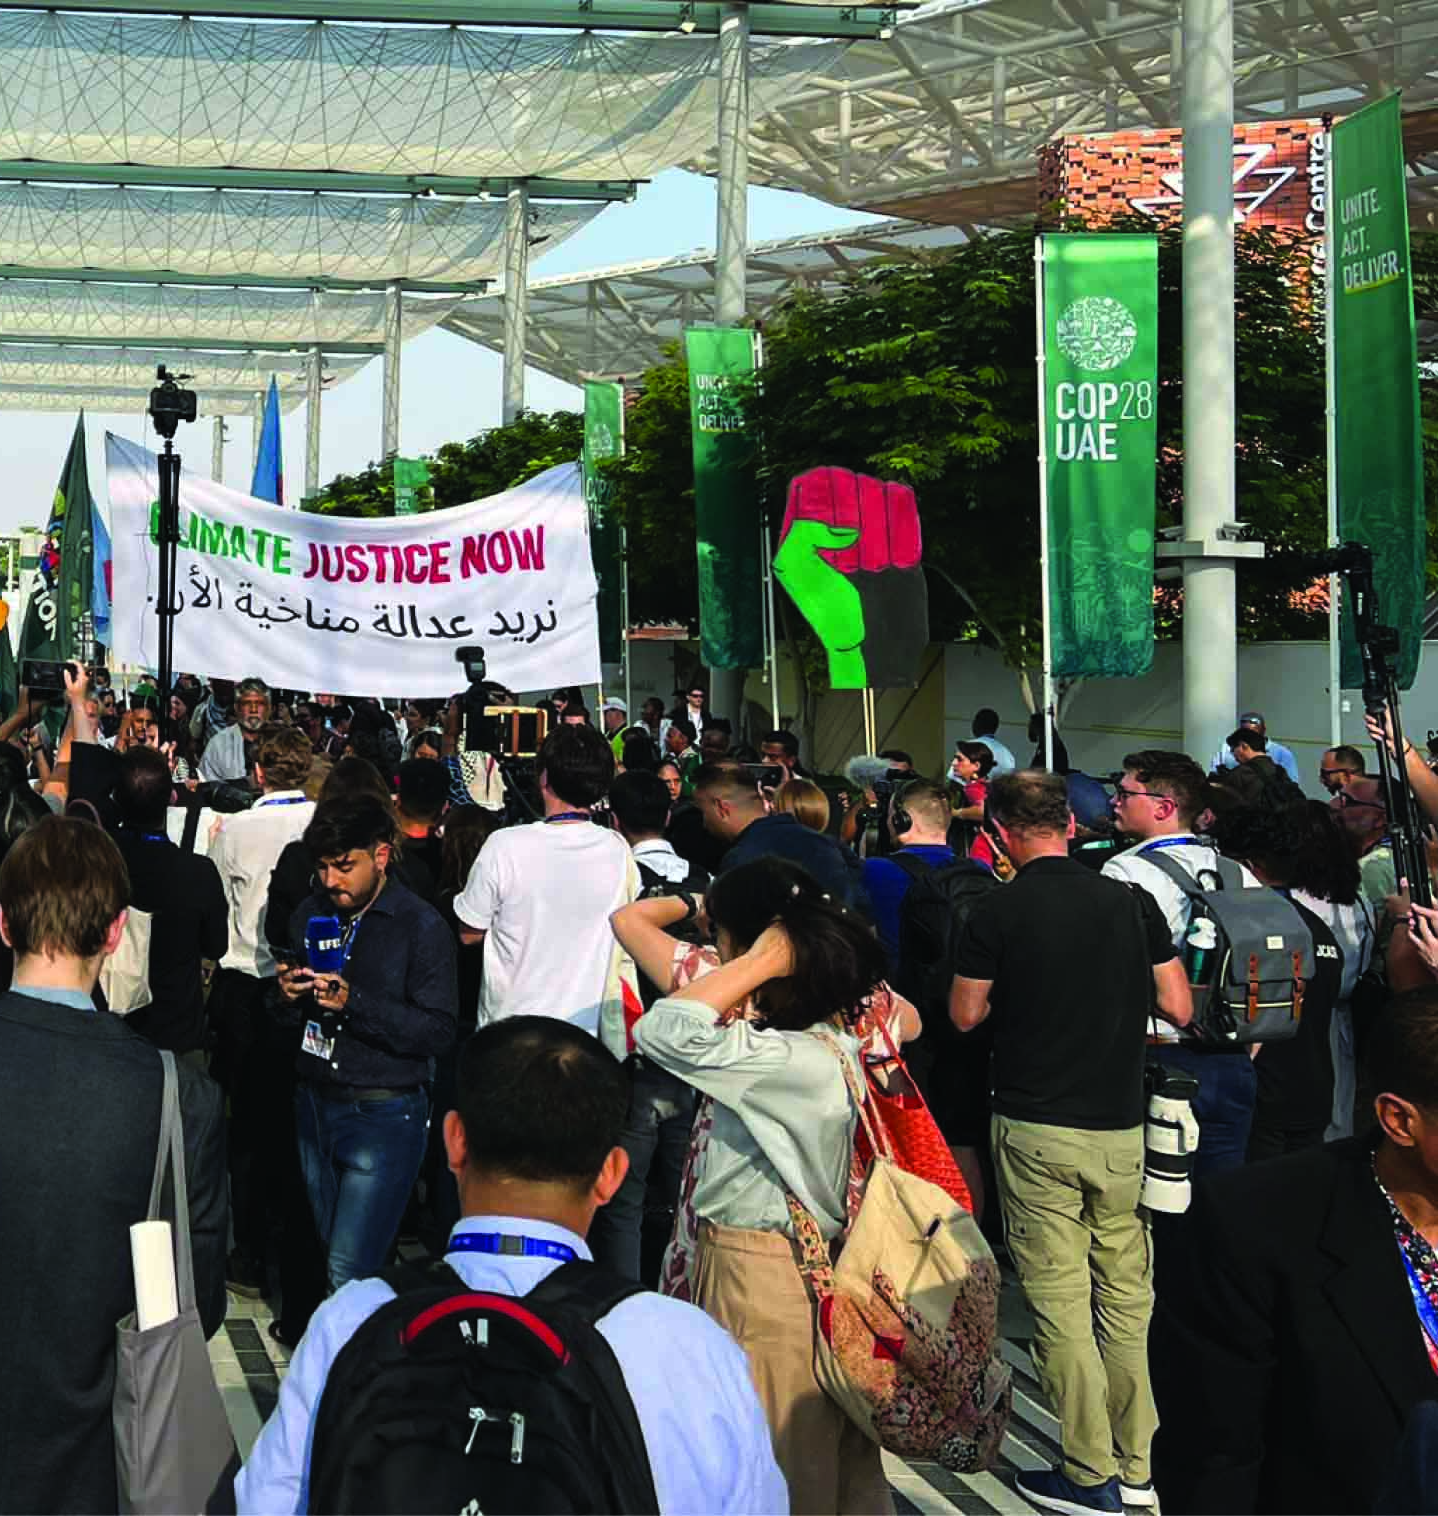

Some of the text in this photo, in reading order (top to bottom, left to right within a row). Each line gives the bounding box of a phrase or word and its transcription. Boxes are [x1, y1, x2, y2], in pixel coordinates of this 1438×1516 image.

[1341, 227, 1371, 259] ACT.
[1343, 250, 1405, 289] DELIVER.
[1055, 380, 1153, 420] COP28
[1055, 422, 1118, 461] UAE
[150, 500, 545, 584] CIMATE JUSTICE NOW
[235, 581, 360, 633] مناخية
[372, 603, 473, 638] عدالة
[488, 600, 558, 643] نريد
